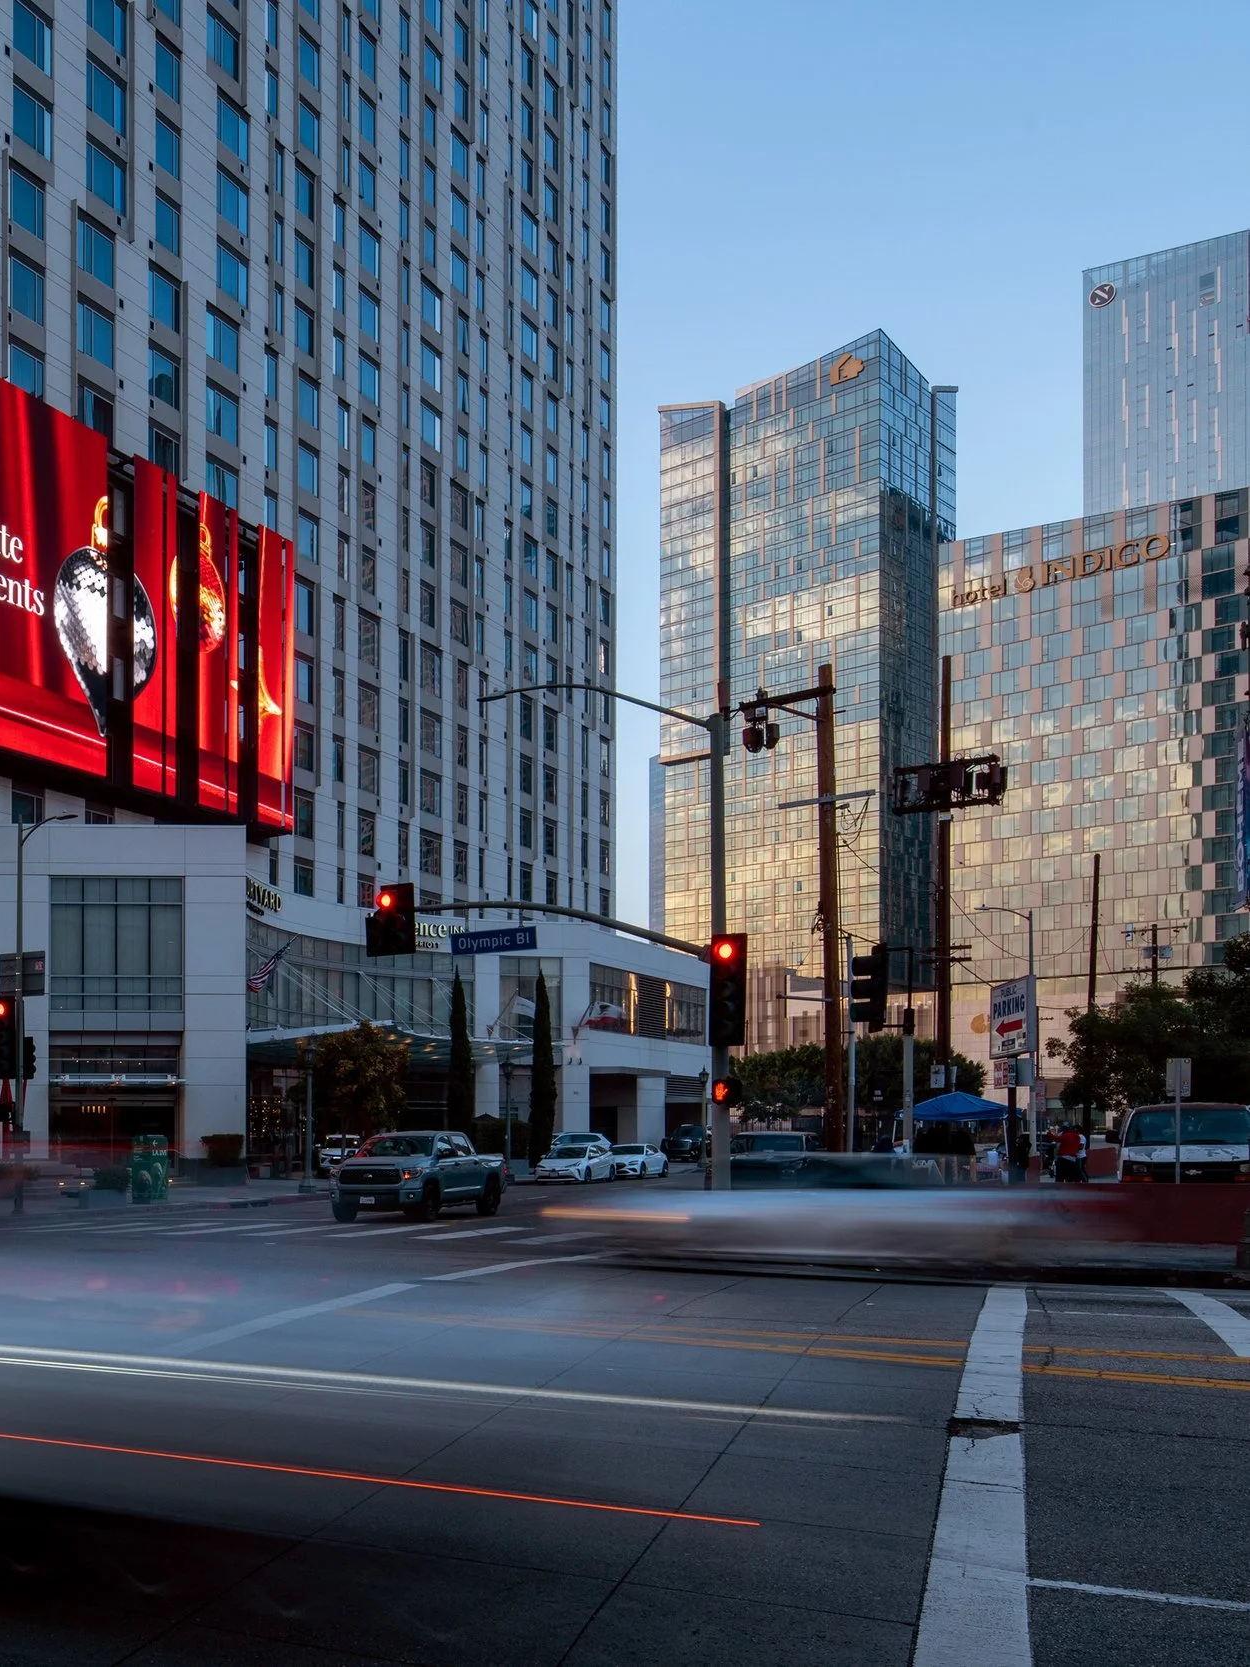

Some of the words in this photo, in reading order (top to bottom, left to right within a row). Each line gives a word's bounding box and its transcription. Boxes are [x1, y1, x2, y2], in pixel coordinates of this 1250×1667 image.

[950, 578, 1007, 608] hotel
[1040, 533, 1171, 587] INDIGO
[458, 934, 511, 951] Olympic
[516, 932, 530, 945] Bl
[1000, 985, 1017, 999] PUBLIC
[993, 994, 1025, 1020] PARKING
